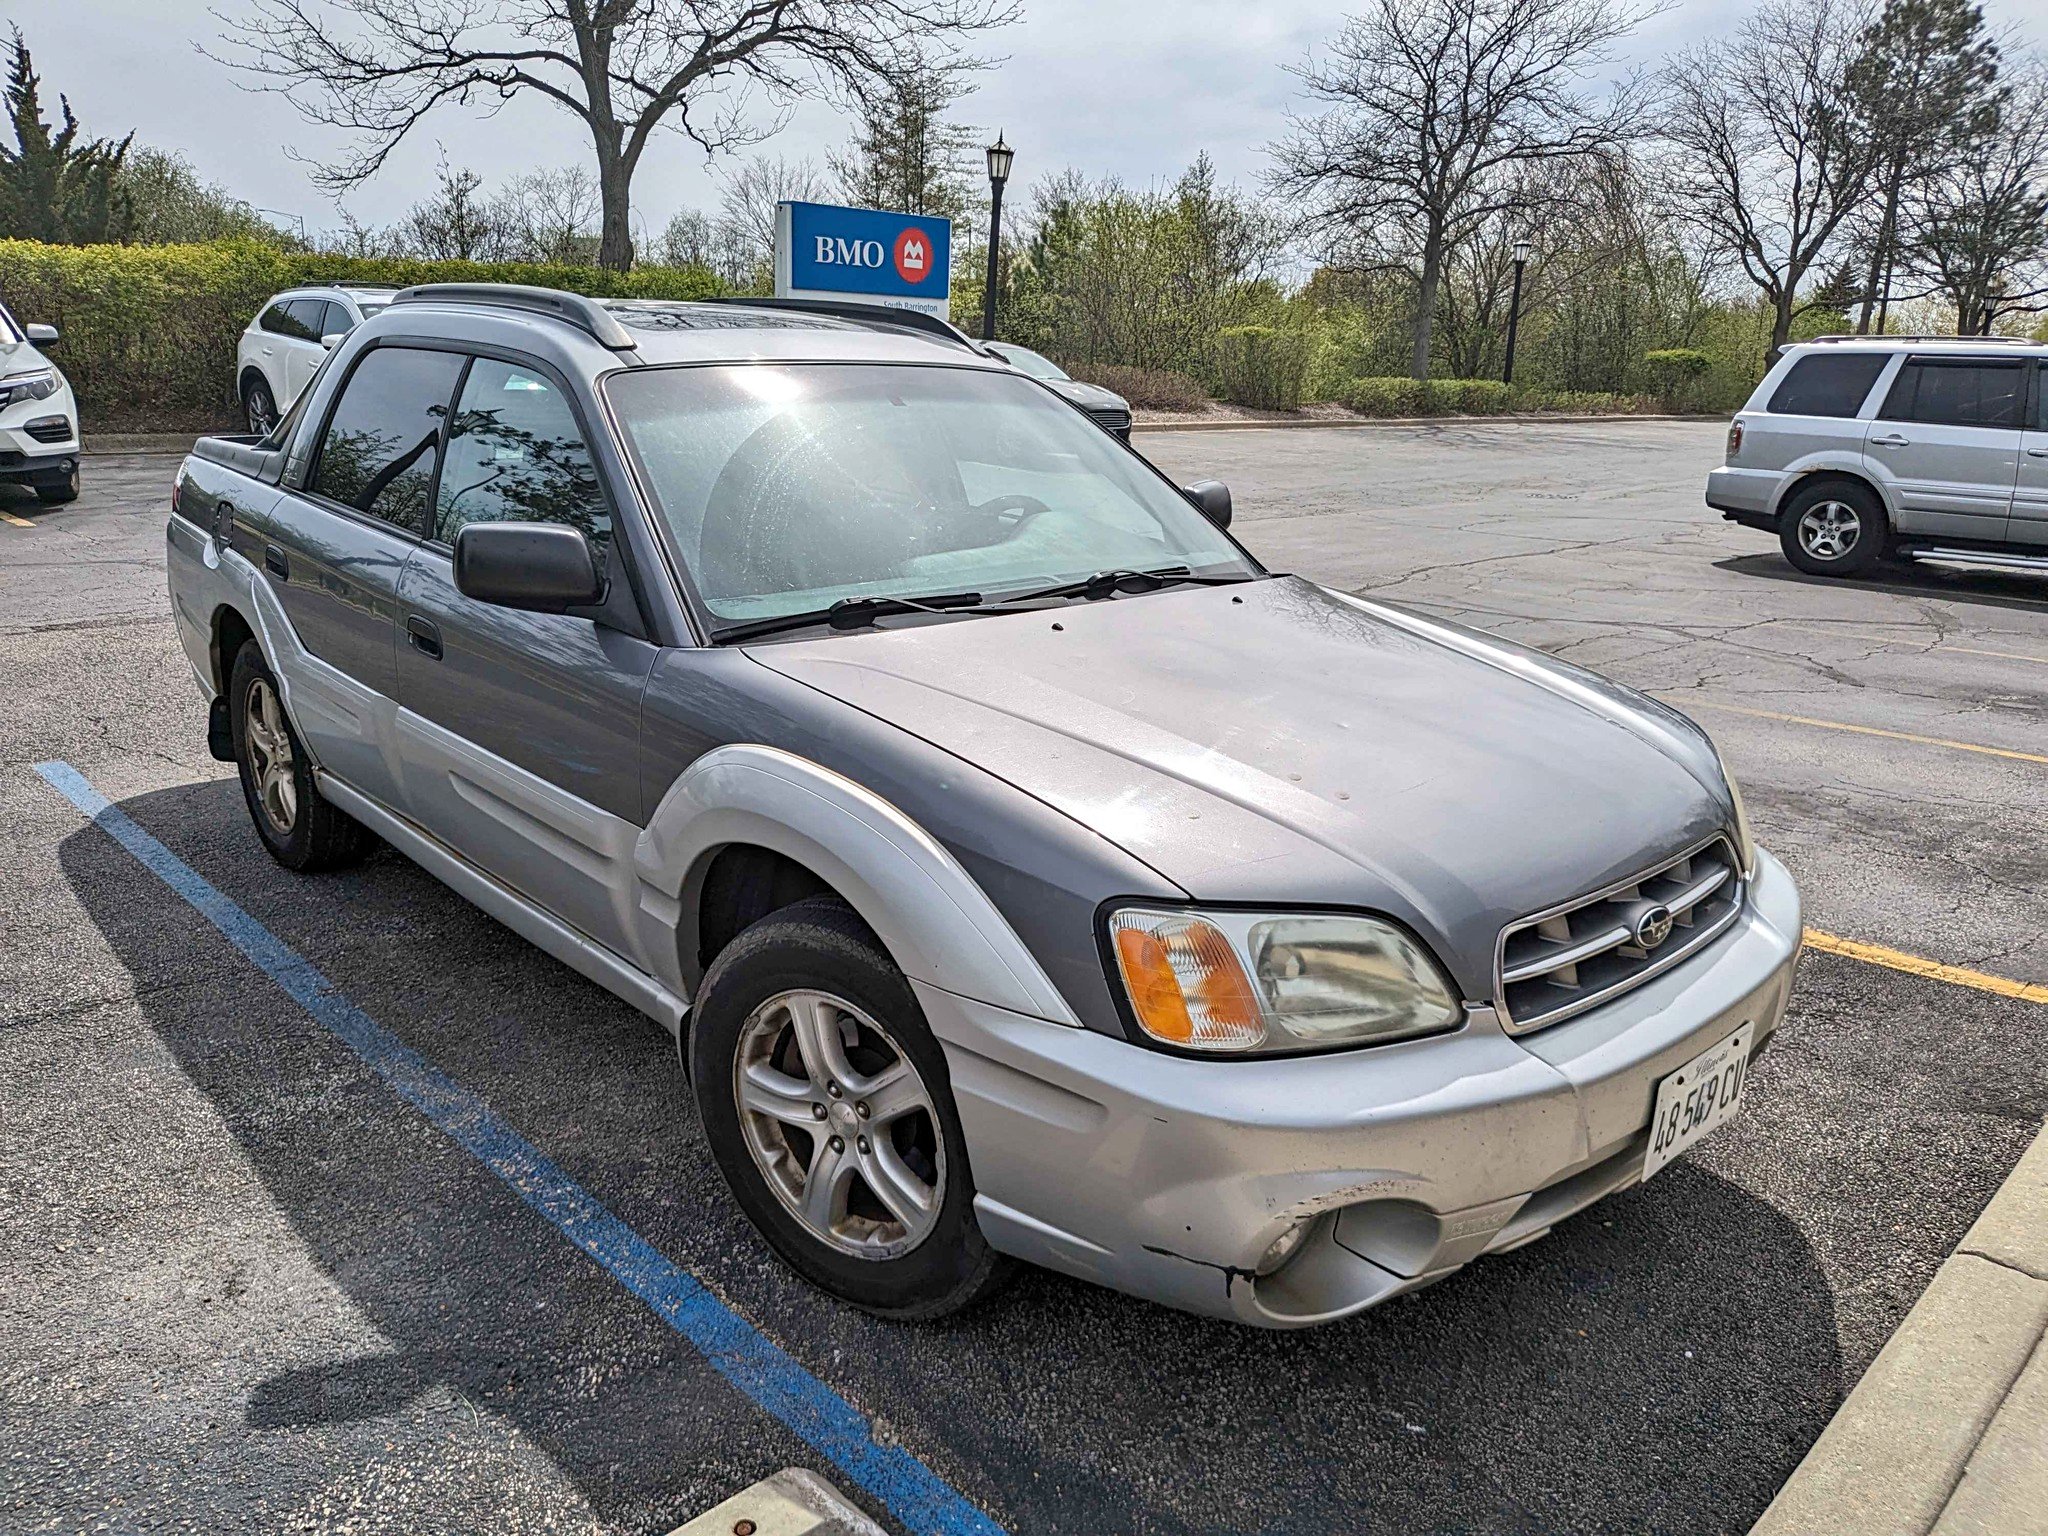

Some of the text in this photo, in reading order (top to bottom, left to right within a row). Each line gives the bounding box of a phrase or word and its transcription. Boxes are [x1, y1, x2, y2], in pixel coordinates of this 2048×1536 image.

[815, 235, 885, 268] BMO
[883, 301, 938, 313] South Barrington
